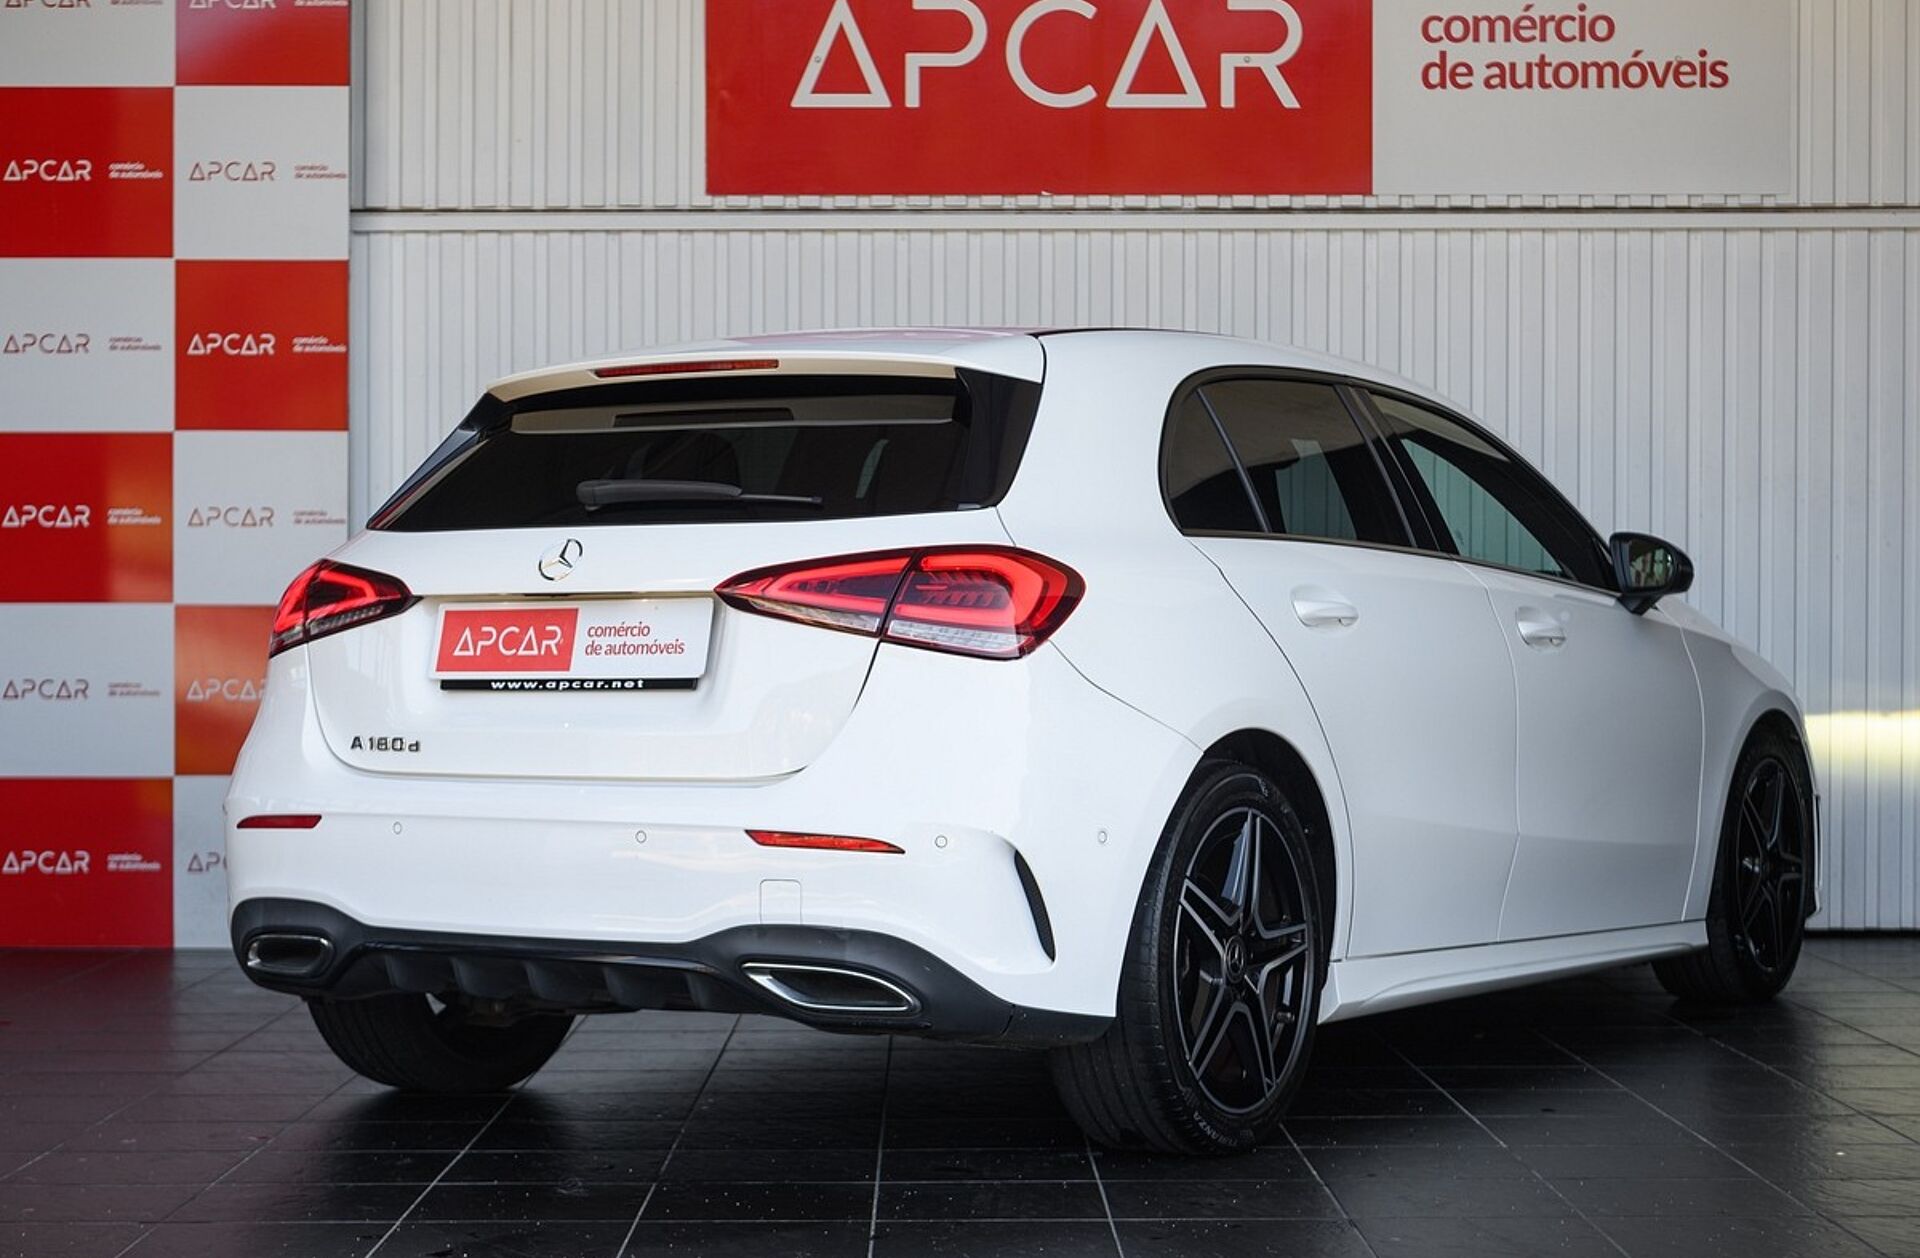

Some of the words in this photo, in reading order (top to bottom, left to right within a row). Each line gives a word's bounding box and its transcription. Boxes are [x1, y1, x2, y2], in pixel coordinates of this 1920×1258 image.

[1421, 3, 1616, 43] comércio
[790, 0, 1303, 108] APCAR
[1421, 50, 1474, 89] de
[1483, 49, 1730, 89] automóveis
[3, 160, 92, 181] APCAR
[189, 161, 276, 181] APCAR
[3, 333, 91, 354] APCAR
[187, 333, 276, 355] APCAR
[2, 505, 91, 528] APCAR
[187, 507, 275, 527] APCAR
[453, 624, 563, 656] APCAR
[587, 621, 651, 638] comércio
[585, 640, 601, 656] de
[604, 638, 686, 656] automóveis
[3, 679, 90, 700] APCAR
[491, 678, 644, 691] www.apcar.net
[351, 736, 363, 750] A
[2, 850, 91, 874] APCAR
